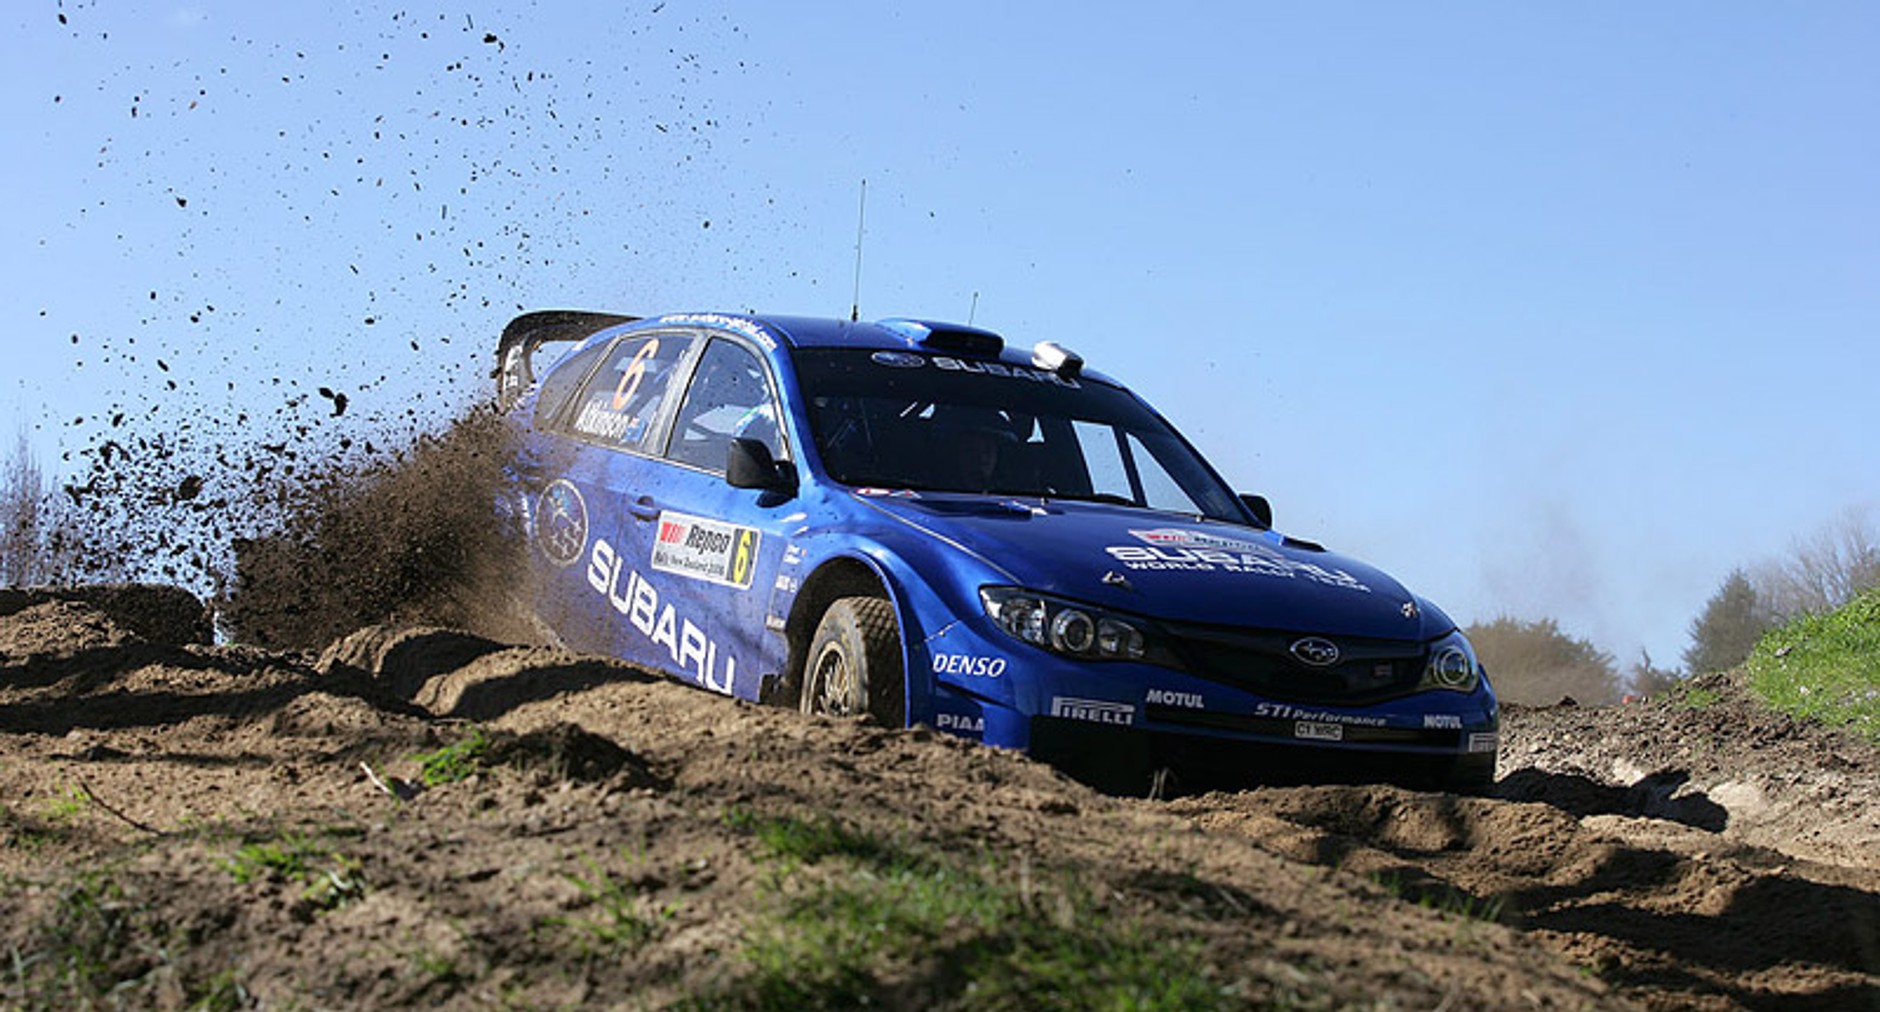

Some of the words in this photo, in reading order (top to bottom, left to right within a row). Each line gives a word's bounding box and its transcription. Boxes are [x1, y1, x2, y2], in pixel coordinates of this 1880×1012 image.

[612, 338, 659, 410] 6
[932, 356, 1081, 389] SUBARU
[685, 524, 732, 555] Repco
[733, 530, 751, 583] 6
[1106, 546, 1357, 584] SUBARU
[1124, 561, 1214, 571] WORLD
[588, 539, 735, 695] SUBARU
[933, 653, 1006, 677] DENSO
[1051, 696, 1135, 725] PIRELLI
[1147, 689, 1204, 709] MOTUL
[937, 713, 984, 731] PIAA
[1255, 703, 1292, 718] STI
[1292, 709, 1387, 727] Performance
[1424, 714, 1463, 729] MOTUL
